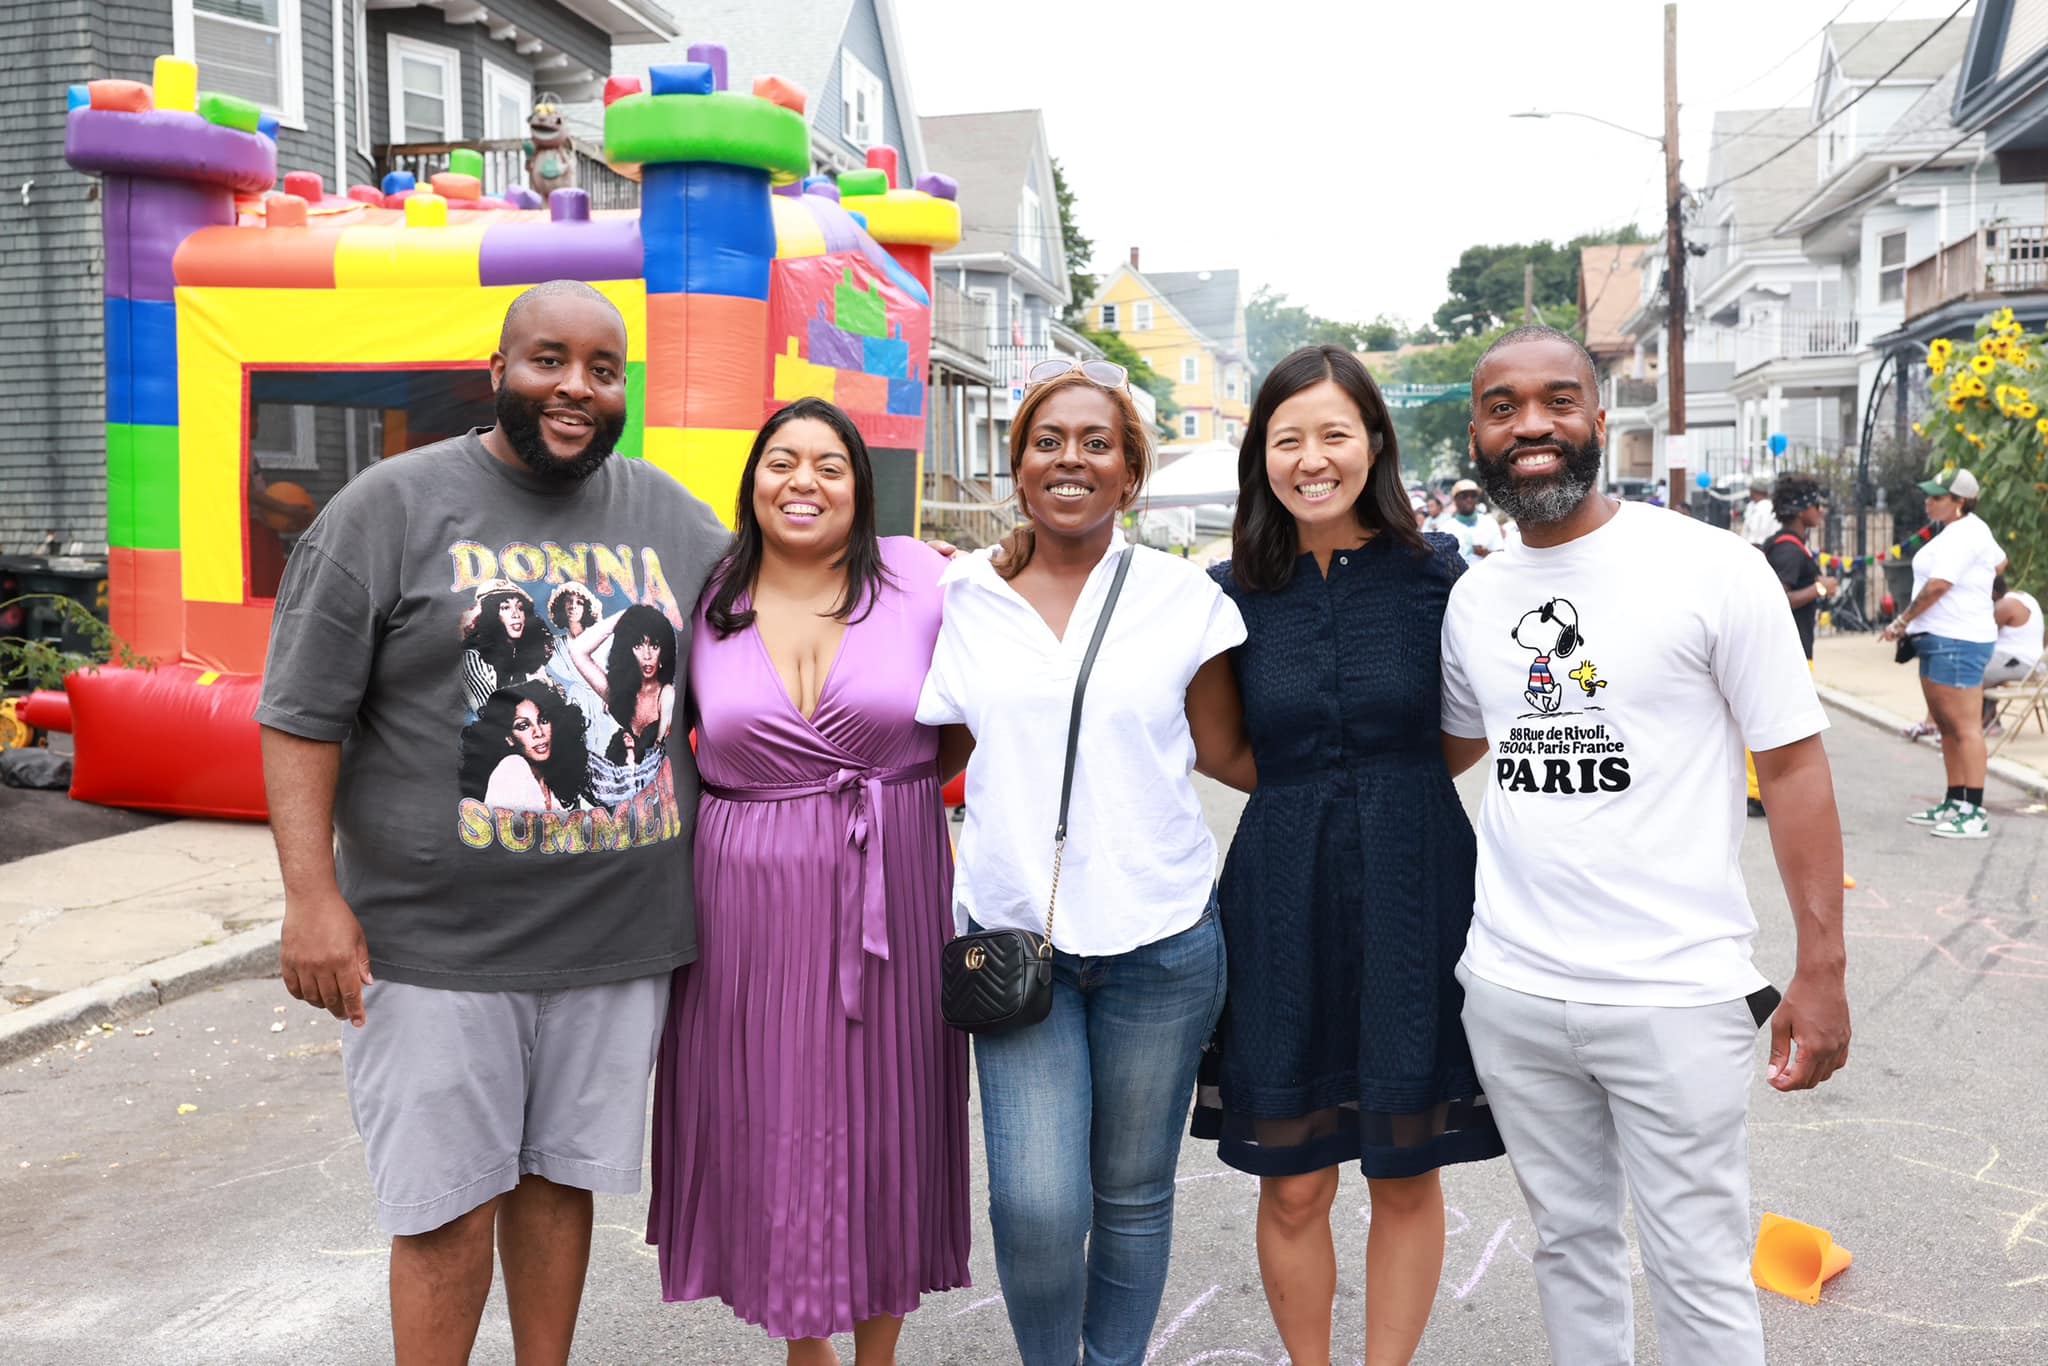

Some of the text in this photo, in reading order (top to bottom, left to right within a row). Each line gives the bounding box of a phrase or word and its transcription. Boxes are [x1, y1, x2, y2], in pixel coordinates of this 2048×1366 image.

[449, 540, 683, 632] DONNA
[1509, 724, 1610, 742] 88 Rue de Rivoli,
[1537, 740, 1571, 754] Paris
[1572, 741, 1625, 754] France
[1496, 757, 1631, 794] PARIS
[458, 756, 682, 853] SUMMER
